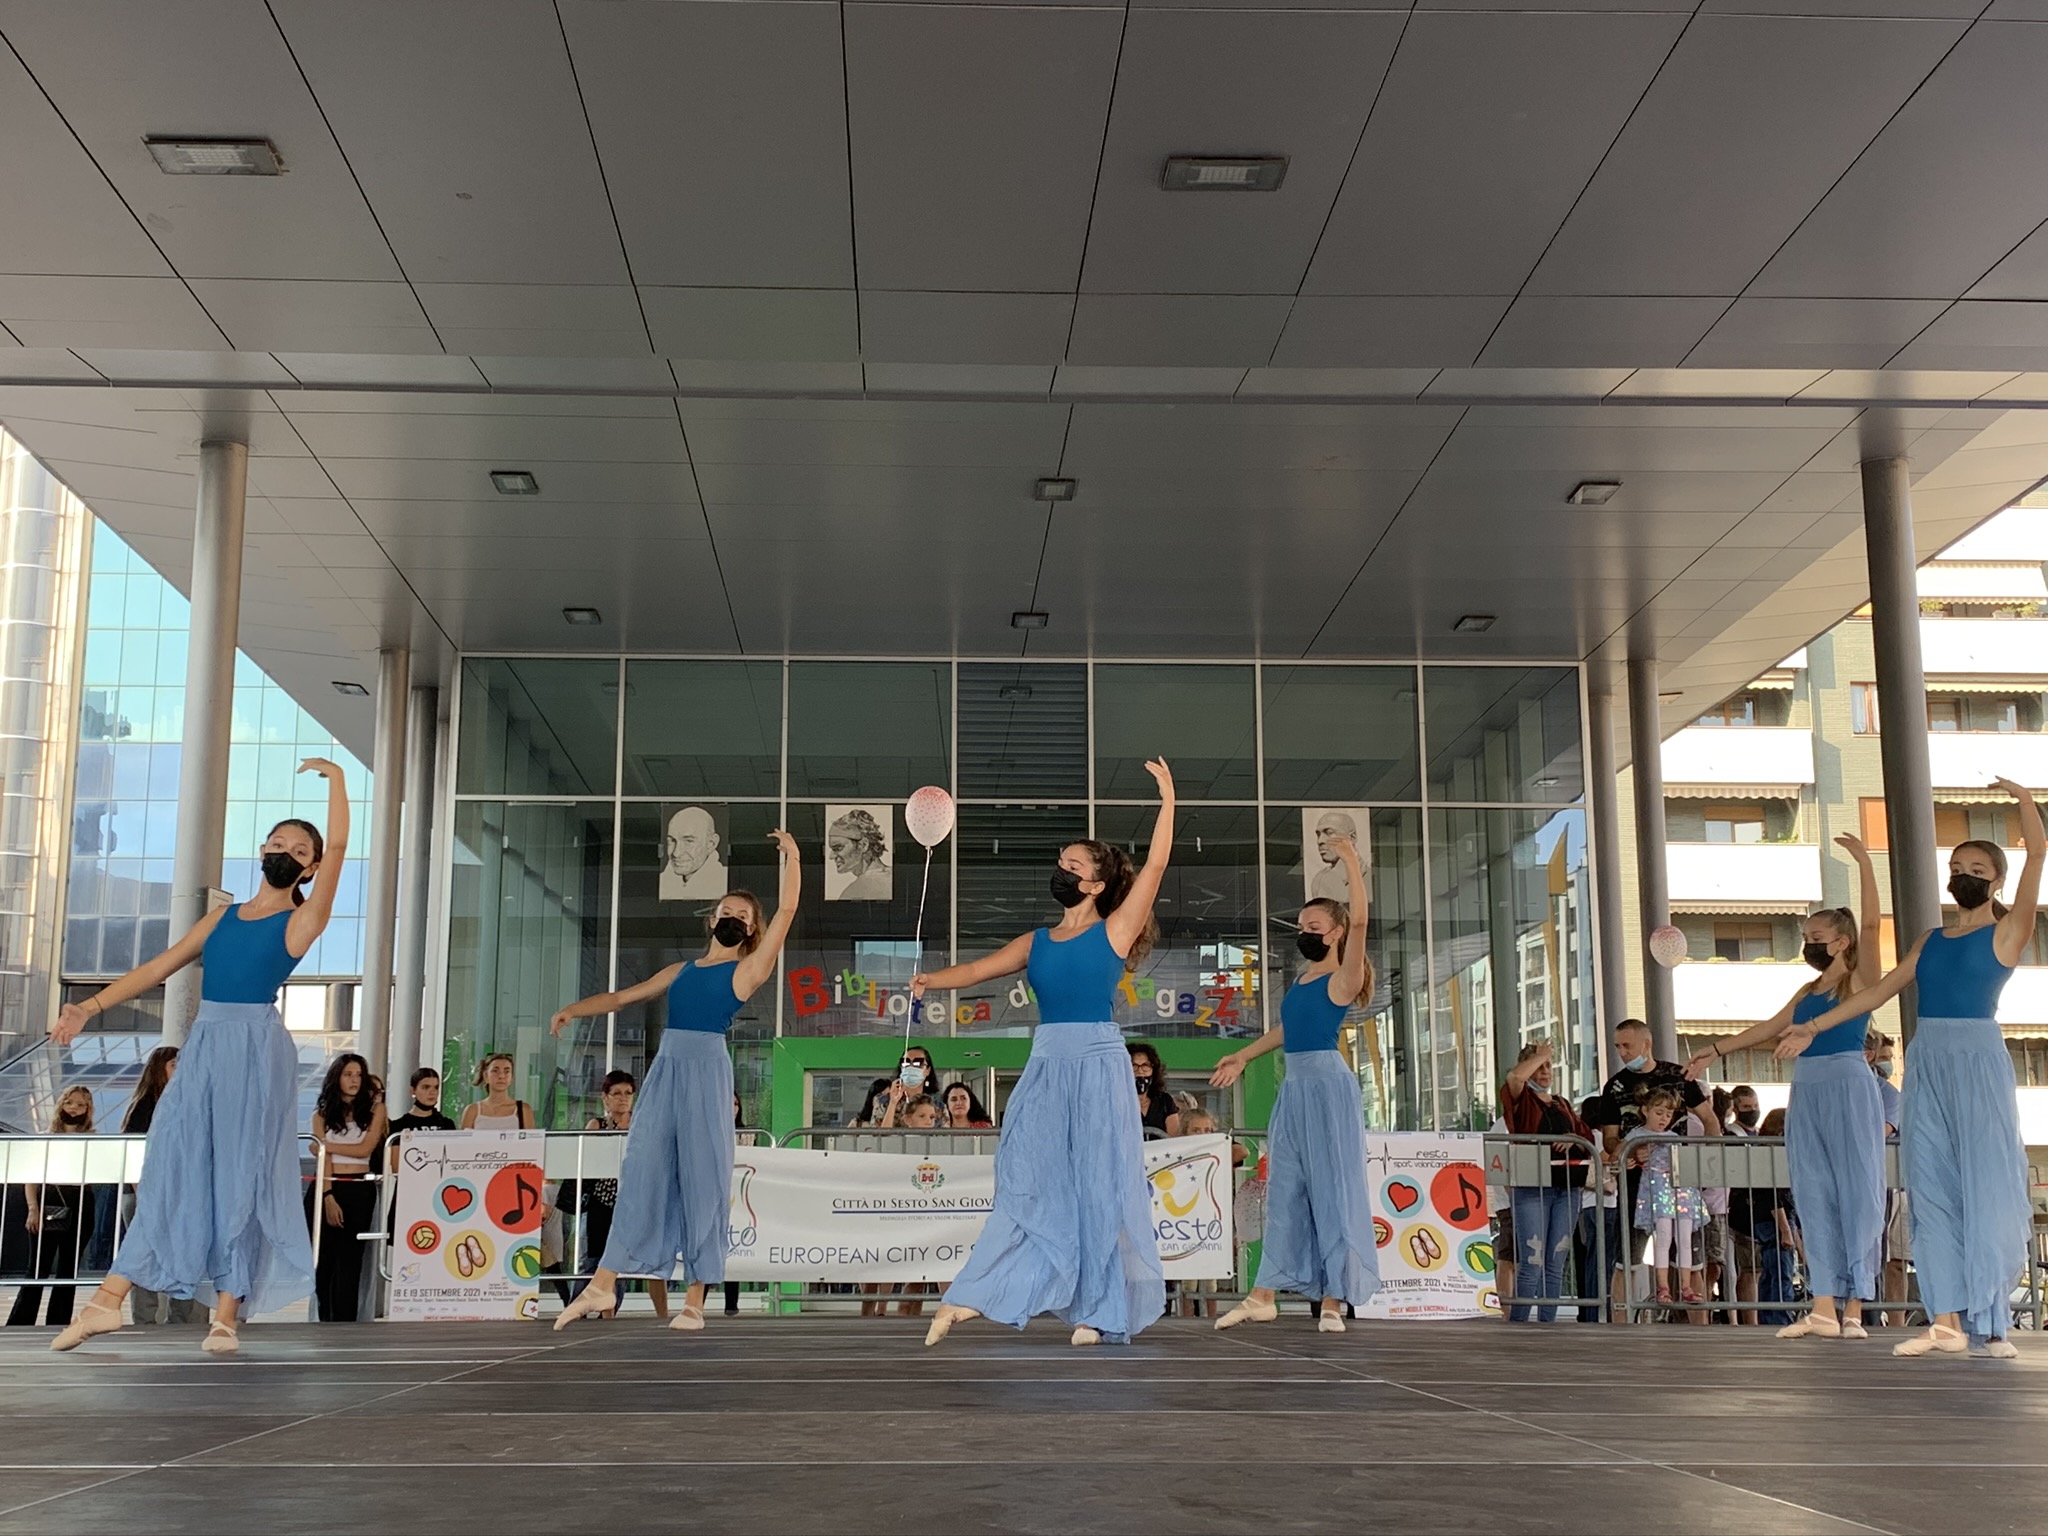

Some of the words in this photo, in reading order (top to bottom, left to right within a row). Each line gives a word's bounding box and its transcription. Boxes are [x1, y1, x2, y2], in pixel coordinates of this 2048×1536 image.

[788, 966, 992, 1025] Biblioteca
[1009, 979, 1038, 1009] d
[959, 1196, 993, 1208] GIOV
[727, 1225, 757, 1247] to
[1158, 1218, 1223, 1241] esto
[769, 1246, 880, 1265] EUROPEAN
[886, 1246, 929, 1263] CITY
[936, 1244, 964, 1261] OF
[393, 1289, 402, 1297] 18
[409, 1289, 418, 1297] 19
[419, 1289, 461, 1297] SETTEMBRE
[463, 1288, 481, 1297] 2021
[1381, 1278, 1422, 1289] SETTEMBRE
[1424, 1278, 1441, 1287] 2021
